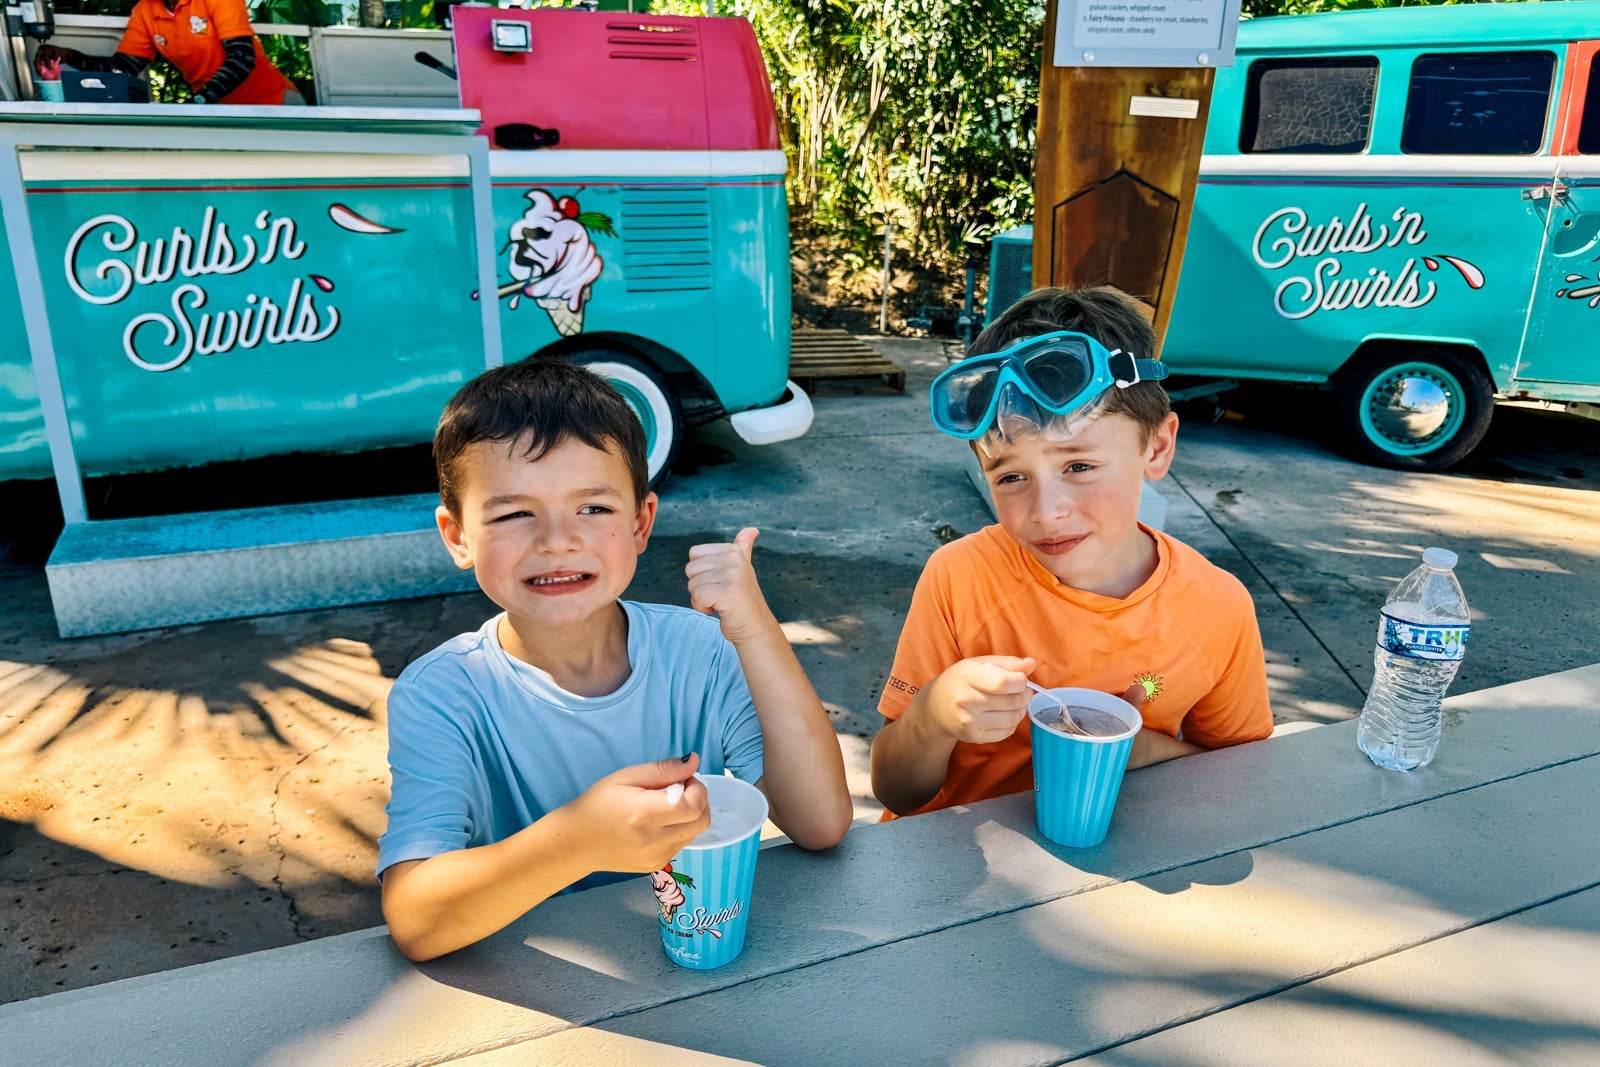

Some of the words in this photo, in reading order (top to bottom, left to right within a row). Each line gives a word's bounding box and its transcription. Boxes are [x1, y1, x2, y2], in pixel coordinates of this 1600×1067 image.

[1088, 14, 1102, 23] Fairy
[1274, 257, 1437, 320] Swirls
[122, 277, 340, 372] Swirls
[888, 676, 909, 691] THE
[676, 898, 745, 930] Swirls
[675, 930, 694, 938] CREAM
